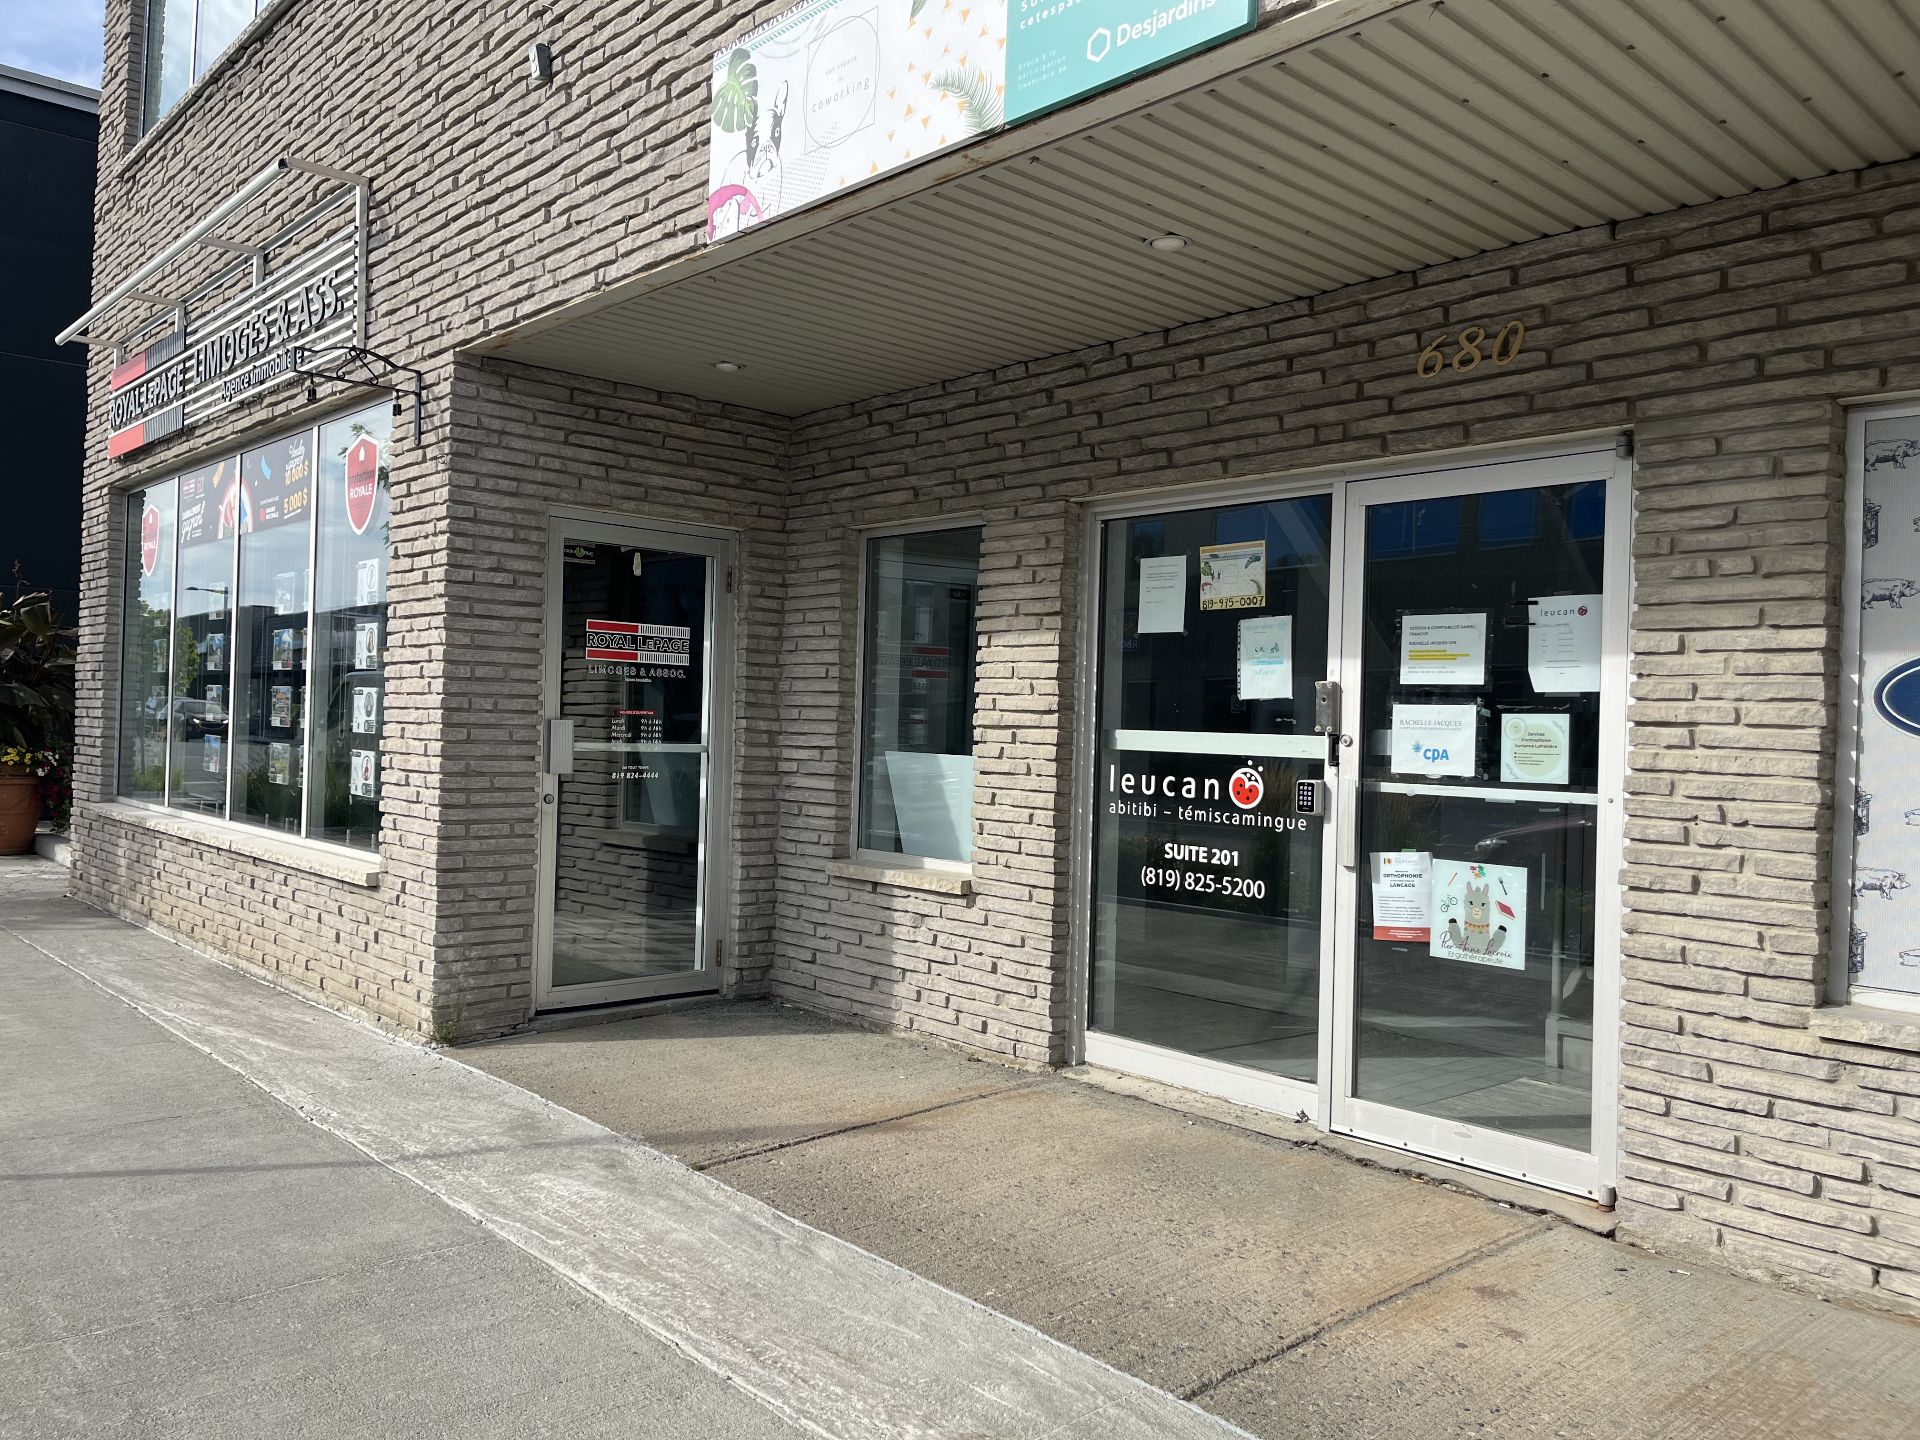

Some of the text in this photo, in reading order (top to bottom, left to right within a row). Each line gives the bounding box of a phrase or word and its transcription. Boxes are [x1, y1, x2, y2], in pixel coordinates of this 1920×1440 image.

[812, 78, 870, 113] coworking
[108, 386, 142, 428] ROYAL
[194, 309, 269, 386] LIMOGES
[274, 299, 290, 343] &
[295, 270, 344, 334] ASS.
[1416, 320, 1525, 379] 680
[222, 375, 249, 401] Agence
[349, 483, 373, 499] ROYALE
[1540, 609, 1575, 617] leucan
[586, 632, 636, 650] ROYAL
[588, 664, 686, 679] LIMOGES & ASSOC.
[626, 771, 659, 779] 824-4444
[1109, 764, 1220, 801] leucan
[1109, 800, 1157, 818] abitibi
[1178, 806, 1307, 832] témiscamingue
[1164, 842, 1239, 867] SUITE 201
[1141, 865, 1266, 899] (819) 825-5200
[1447, 950, 1504, 965] Ergothérapeute
